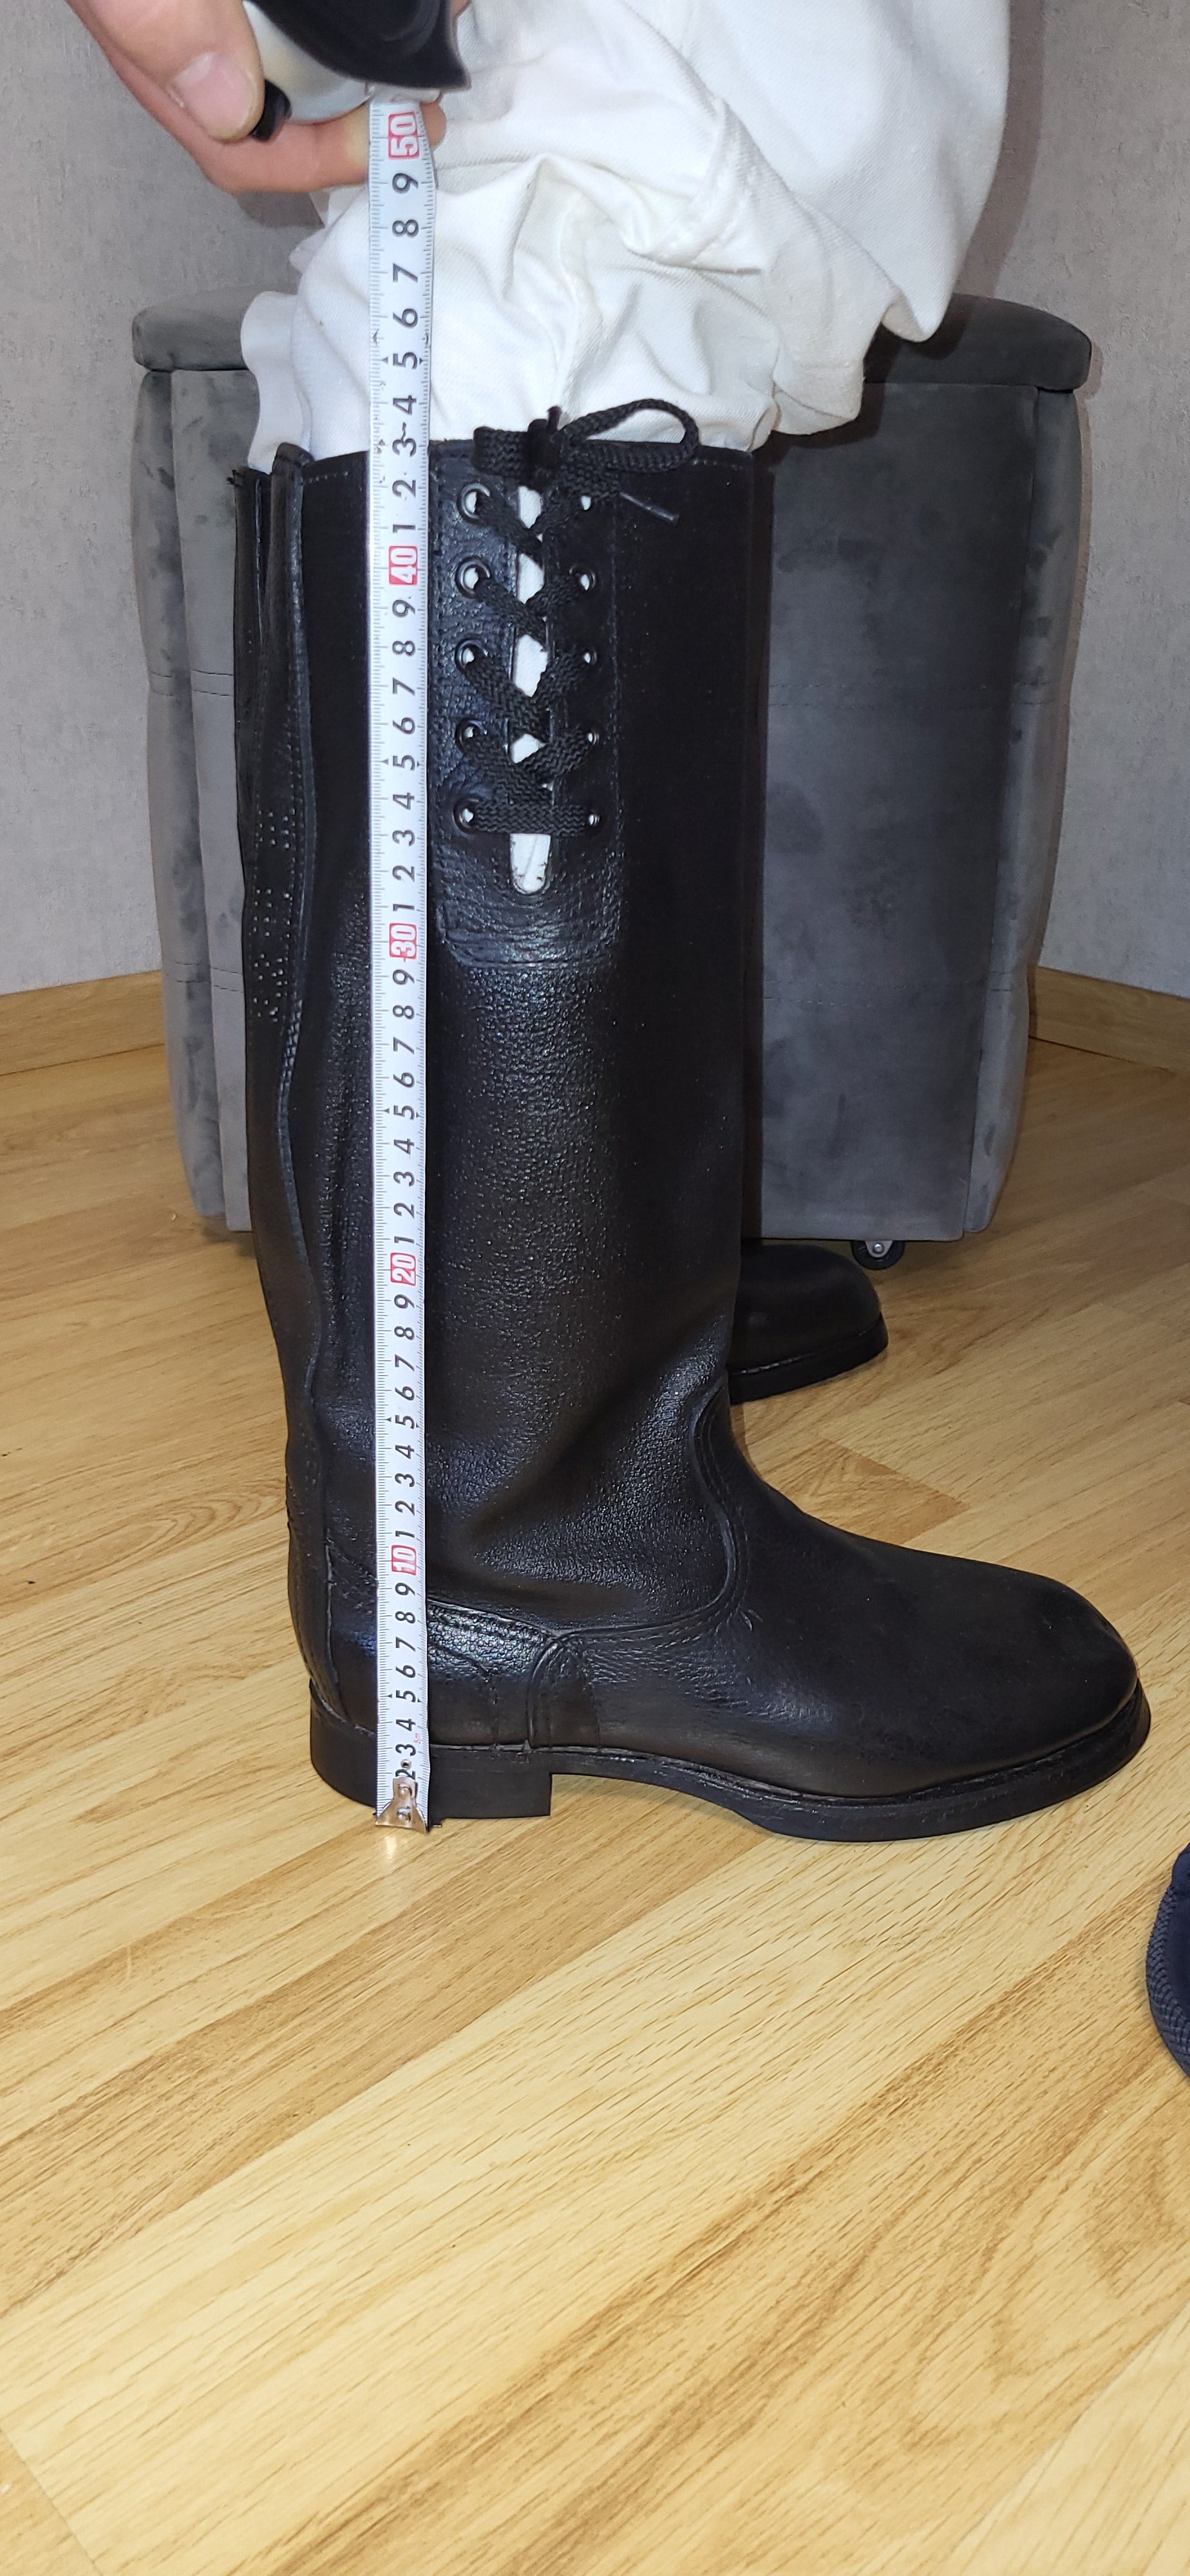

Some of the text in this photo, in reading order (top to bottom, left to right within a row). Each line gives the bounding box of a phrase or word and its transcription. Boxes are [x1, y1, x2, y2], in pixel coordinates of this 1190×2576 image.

[390, 114, 419, 156] 50
[392, 173, 419, 192] 9
[392, 219, 419, 236] 8
[393, 263, 418, 281] 7
[393, 308, 418, 328] 6
[392, 352, 418, 369] 5
[392, 395, 417, 415] 4
[392, 437, 417, 457] 3
[392, 480, 416, 497] 2
[392, 524, 416, 533] 1
[390, 546, 417, 584] 40
[392, 600, 415, 618] 9
[392, 640, 416, 656] 8
[392, 677, 415, 695] 7
[392, 717, 415, 734] 6
[392, 755, 415, 770] 5
[392, 792, 415, 810] 4
[392, 829, 415, 846] 3
[392, 866, 415, 881] 2
[390, 923, 416, 958] 30
[392, 969, 415, 985] 9
[392, 1005, 414, 1019] 8
[393, 1037, 415, 1054] 7
[393, 1072, 415, 1088] 6
[393, 1105, 415, 1120] 5
[393, 1138, 415, 1155] 4
[393, 1171, 415, 1187] 3
[393, 1202, 415, 1218] 2
[391, 1253, 416, 1285] 20
[393, 1294, 415, 1309] 9
[393, 1326, 415, 1341] 8
[394, 1354, 415, 1372] 7
[395, 1386, 415, 1401] 6
[395, 1414, 415, 1430] 5
[395, 1444, 415, 1459] 4
[394, 1473, 415, 1488] 3
[394, 1501, 415, 1516] 2
[395, 1530, 415, 1539] 1
[391, 1546, 416, 1575] 10
[395, 1582, 415, 1596] 9
[395, 1611, 416, 1624] 8
[395, 1636, 416, 1652] 7
[395, 1665, 416, 1678] 6
[395, 1690, 416, 1703] 5
[395, 1718, 416, 1732] 4
[395, 1743, 417, 1757] 3
